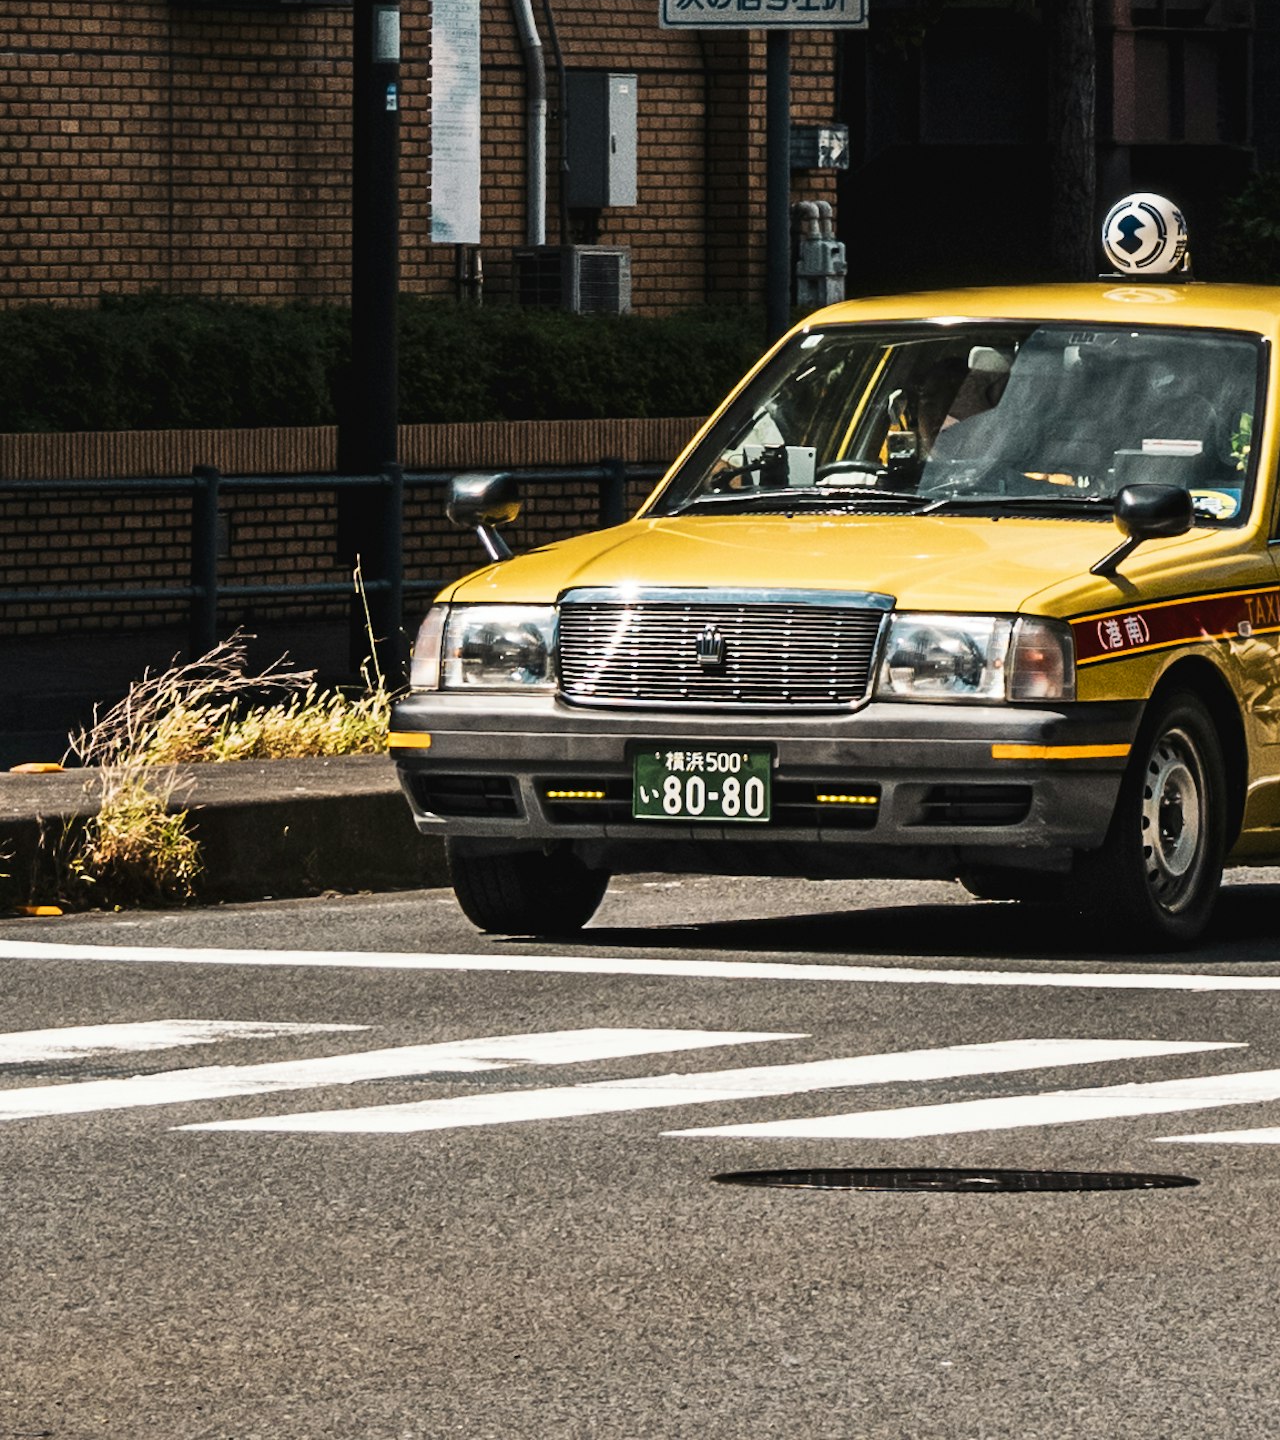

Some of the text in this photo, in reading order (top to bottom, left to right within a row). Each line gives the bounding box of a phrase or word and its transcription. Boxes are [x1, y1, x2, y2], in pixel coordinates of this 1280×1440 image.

[665, 751, 741, 773] 横浜500
[639, 775, 765, 817] い 80-80
